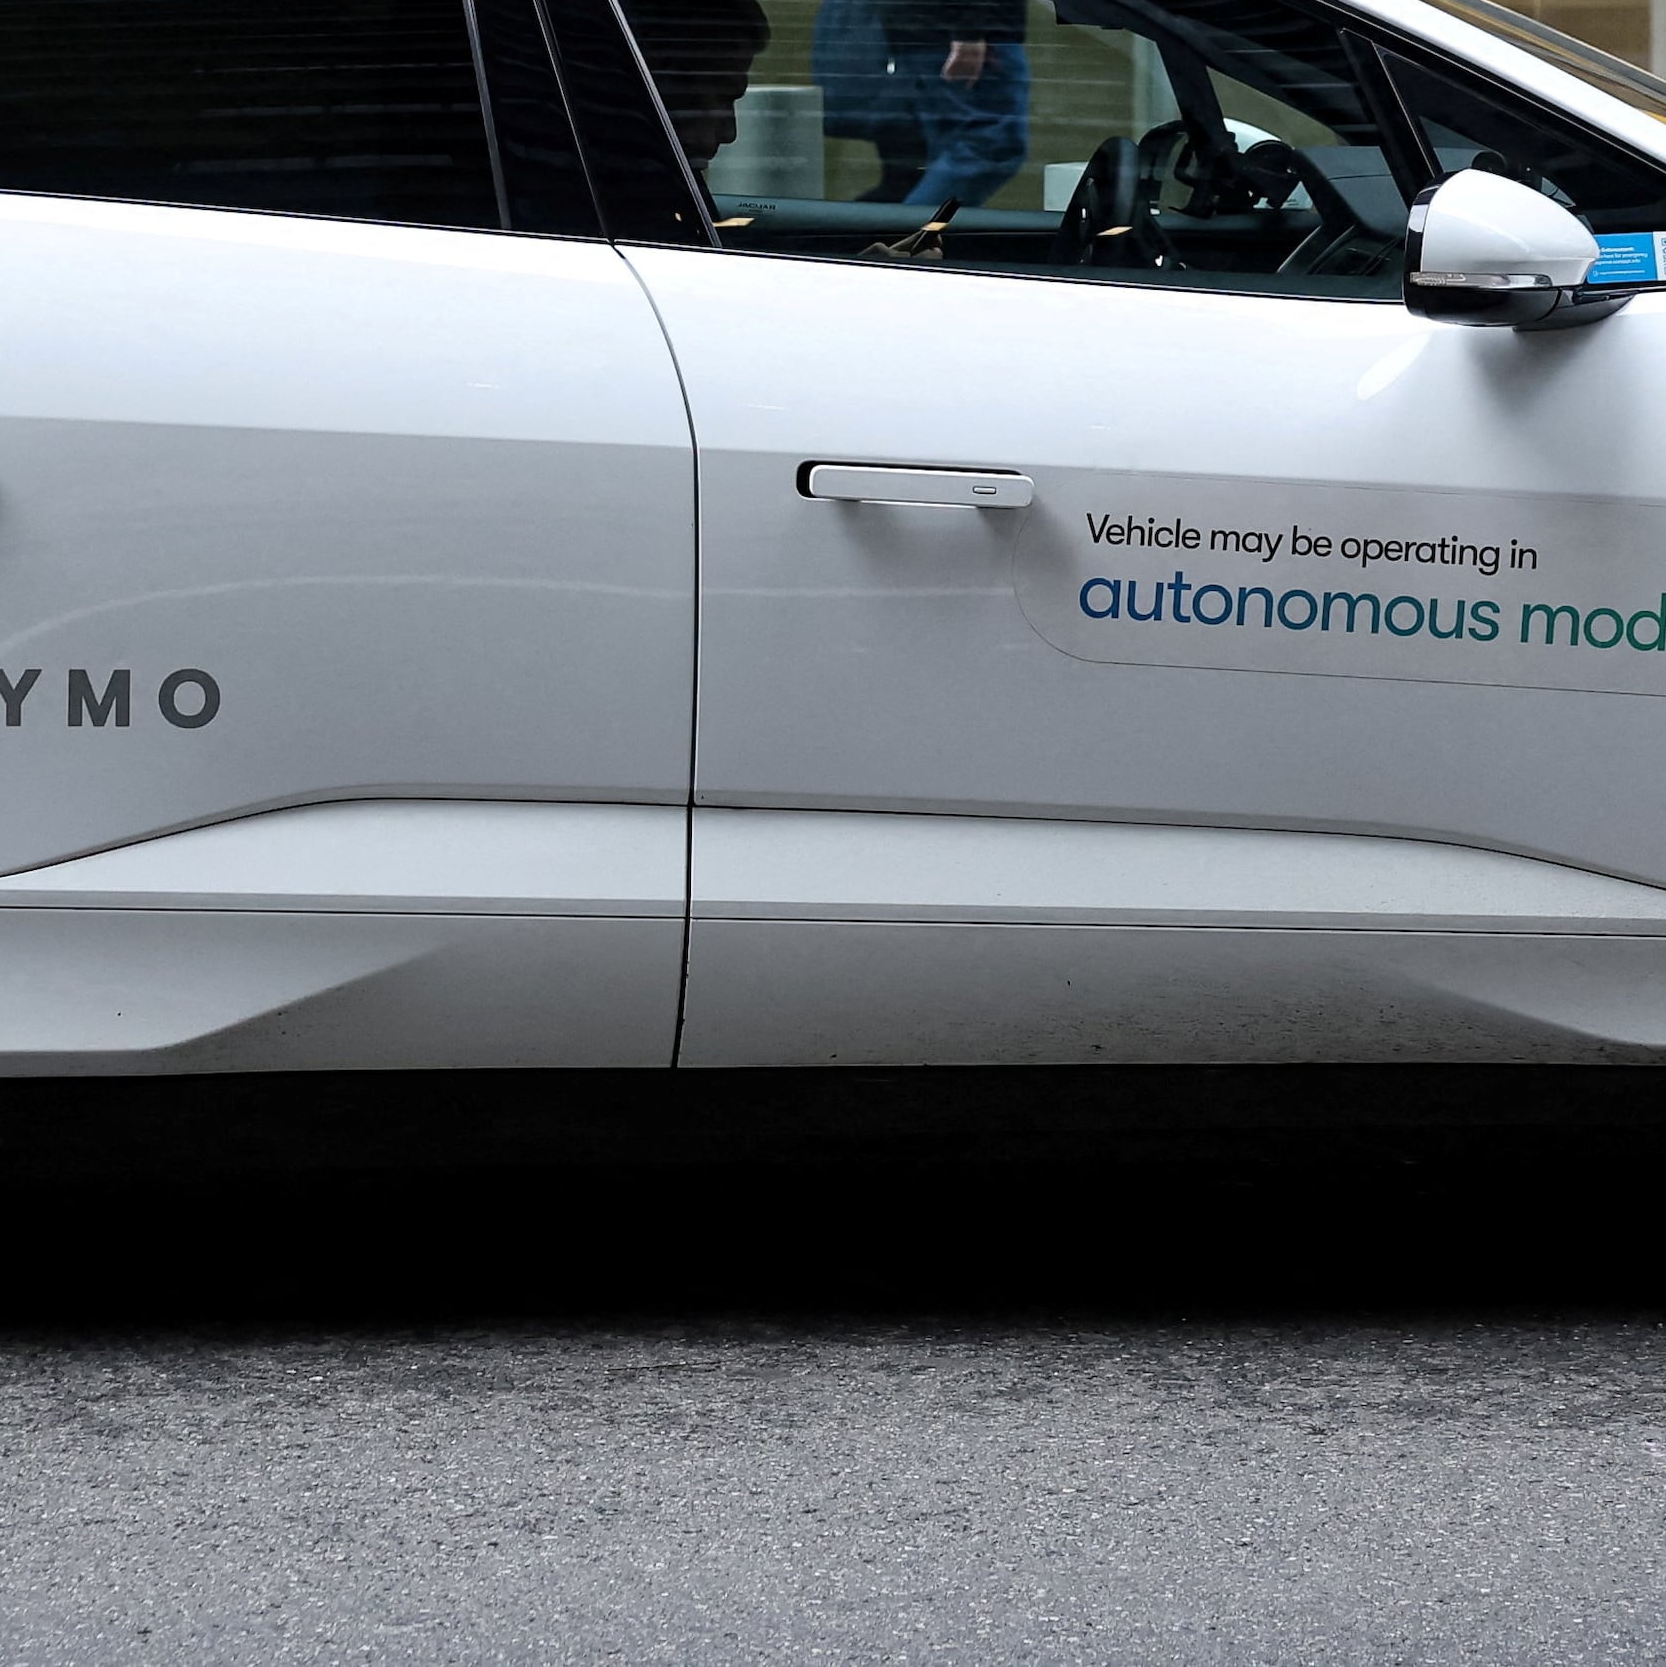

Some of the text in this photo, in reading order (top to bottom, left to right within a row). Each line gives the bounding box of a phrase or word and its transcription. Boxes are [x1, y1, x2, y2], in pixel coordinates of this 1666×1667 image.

[1086, 512, 1537, 576] Vehicle may be operating in
[1078, 570, 1501, 642] autonomous
